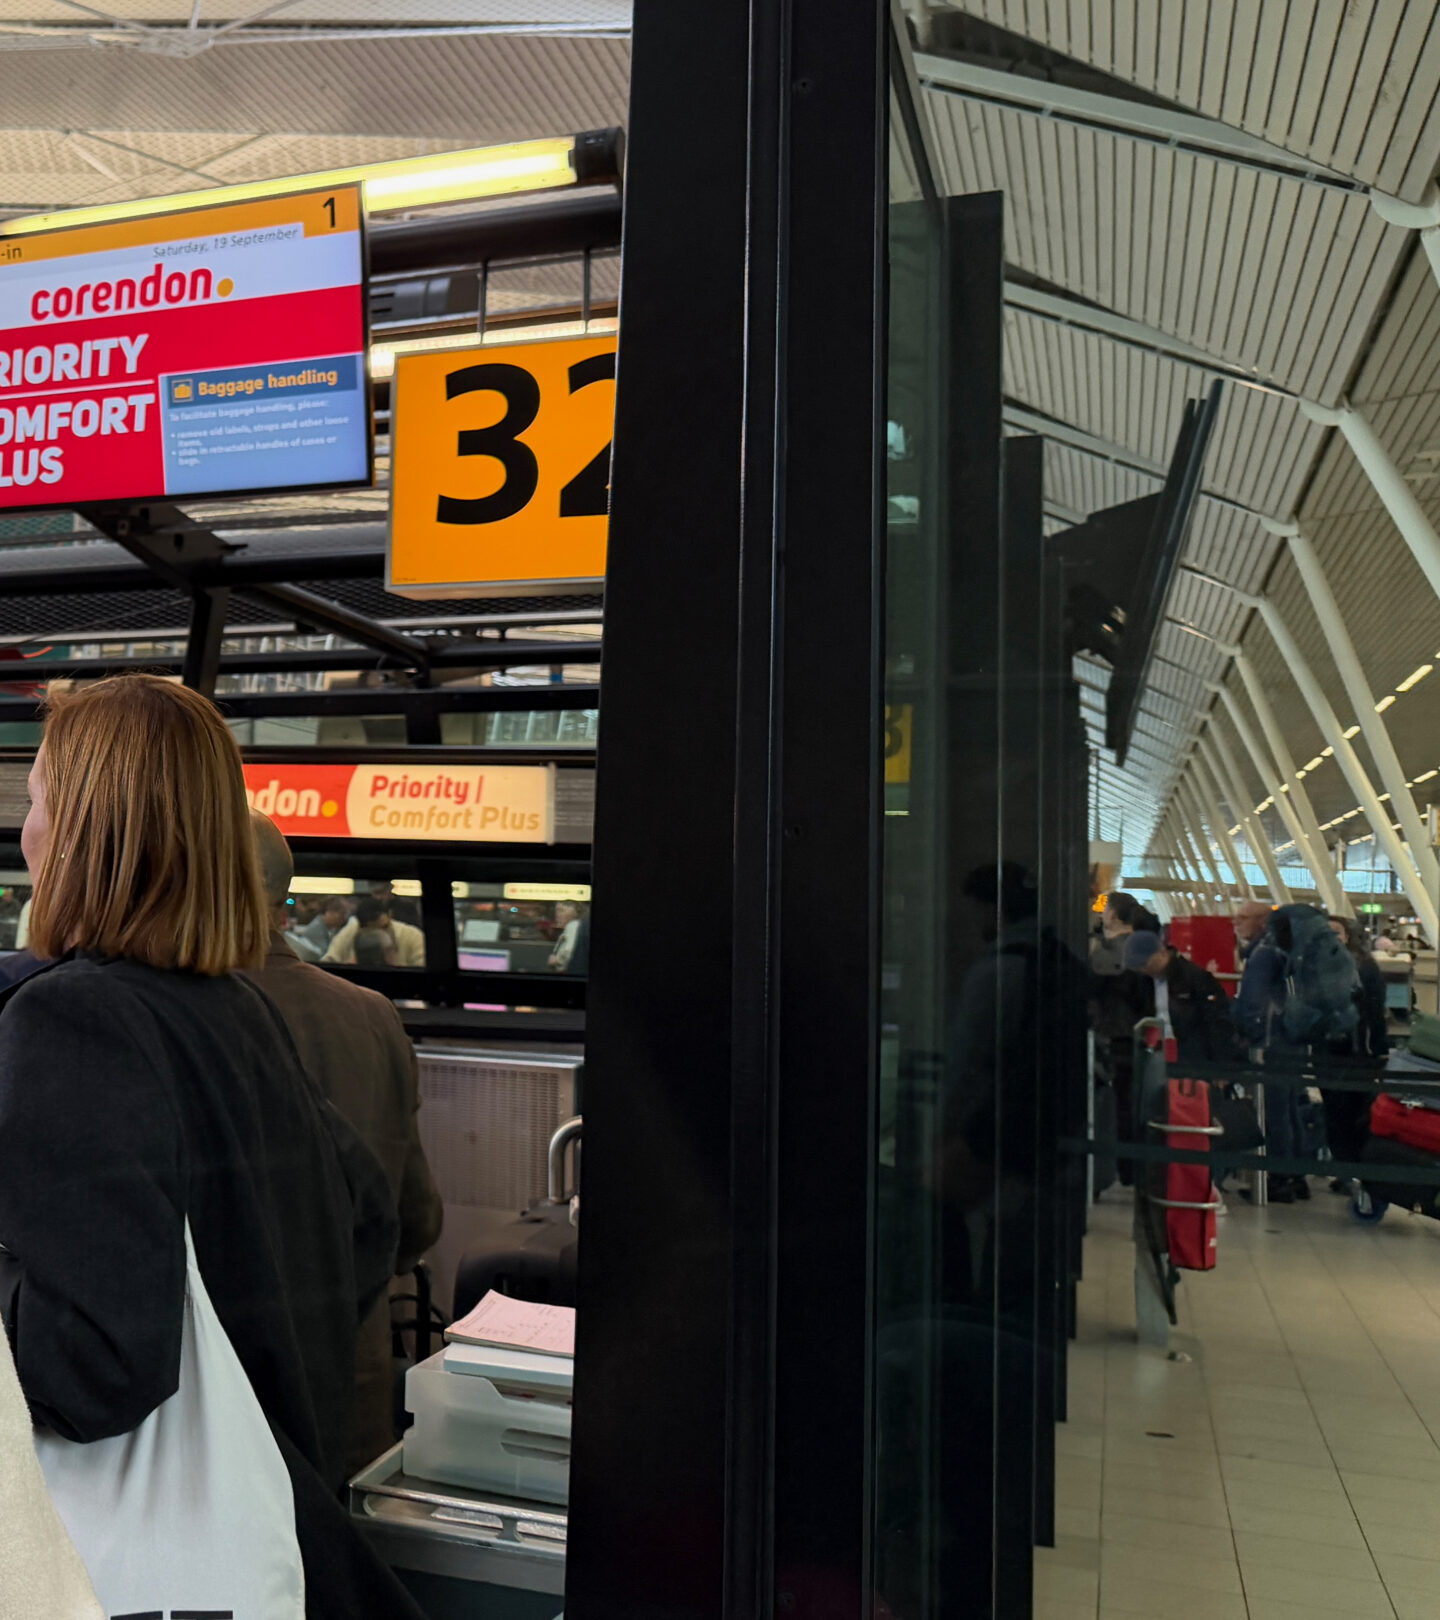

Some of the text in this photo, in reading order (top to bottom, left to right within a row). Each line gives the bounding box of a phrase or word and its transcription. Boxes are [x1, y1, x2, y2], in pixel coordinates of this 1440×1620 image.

[322, 196, 336, 229] 1
[153, 228, 299, 259] Saturday, 19 September
[198, 369, 338, 398] Baggage handling
[369, 774, 470, 805] Priority
[369, 804, 541, 832] Comfort Plus
